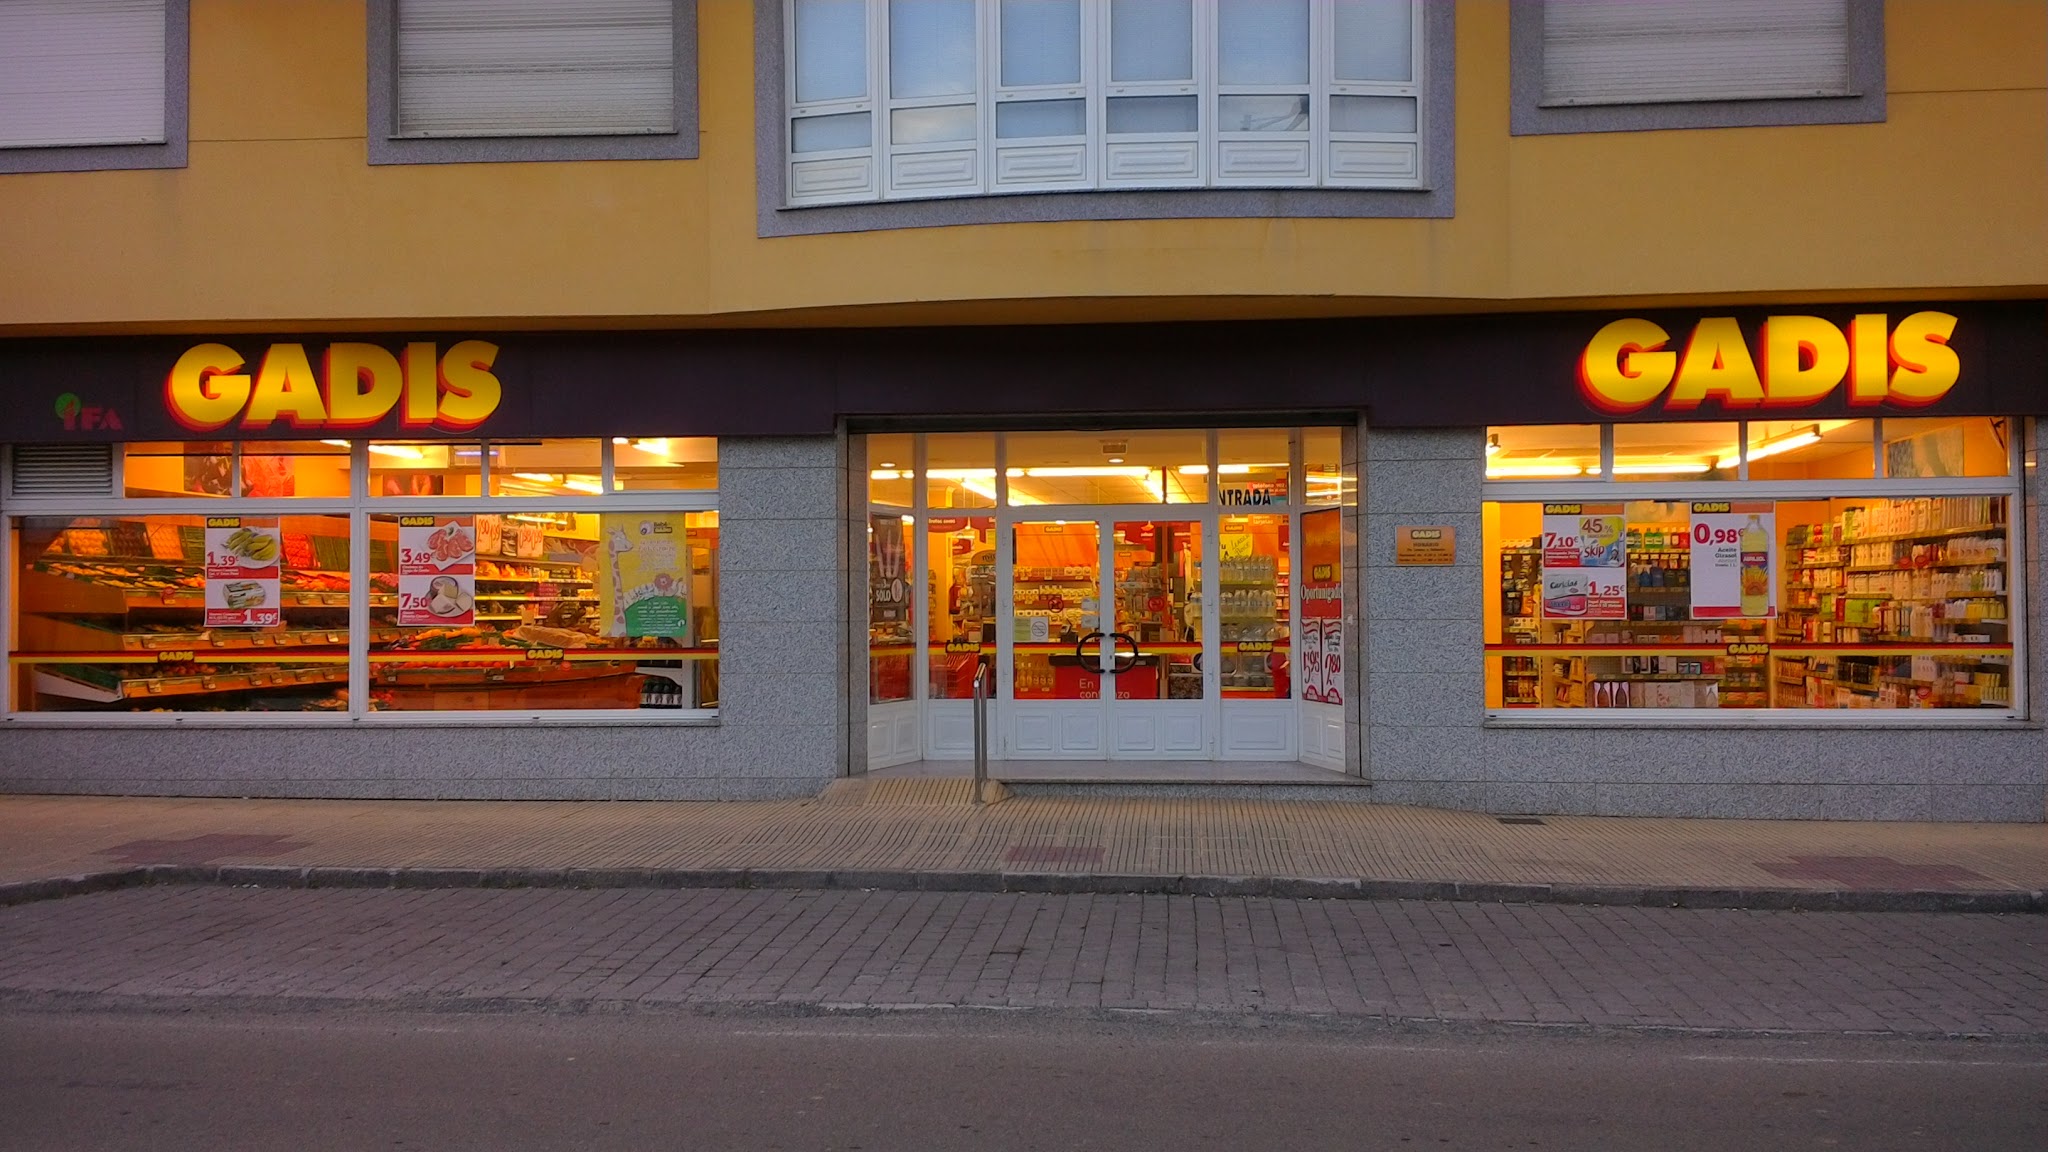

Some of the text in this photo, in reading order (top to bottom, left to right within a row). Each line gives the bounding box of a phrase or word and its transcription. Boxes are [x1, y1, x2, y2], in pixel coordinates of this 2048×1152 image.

[1574, 311, 1960, 414] GADIS
[163, 340, 502, 432] GADIS
[1219, 489, 1271, 505] NTRADA
[1545, 504, 1581, 514] GADIS
[1693, 503, 1730, 512] GADIS
[208, 518, 240, 527] GADIS
[401, 517, 434, 526] GADIS
[1313, 566, 1331, 579] GADIS
[1588, 581, 1625, 598] 1,25€
[401, 593, 431, 609] 7,50
[876, 590, 891, 602] SOLO
[947, 643, 980, 652] GADIS
[1238, 642, 1273, 651] GADIS
[1728, 644, 1769, 654] GADIS
[159, 651, 194, 661] GADIS
[527, 649, 564, 659] GADIS
[1080, 678, 1094, 689] En
